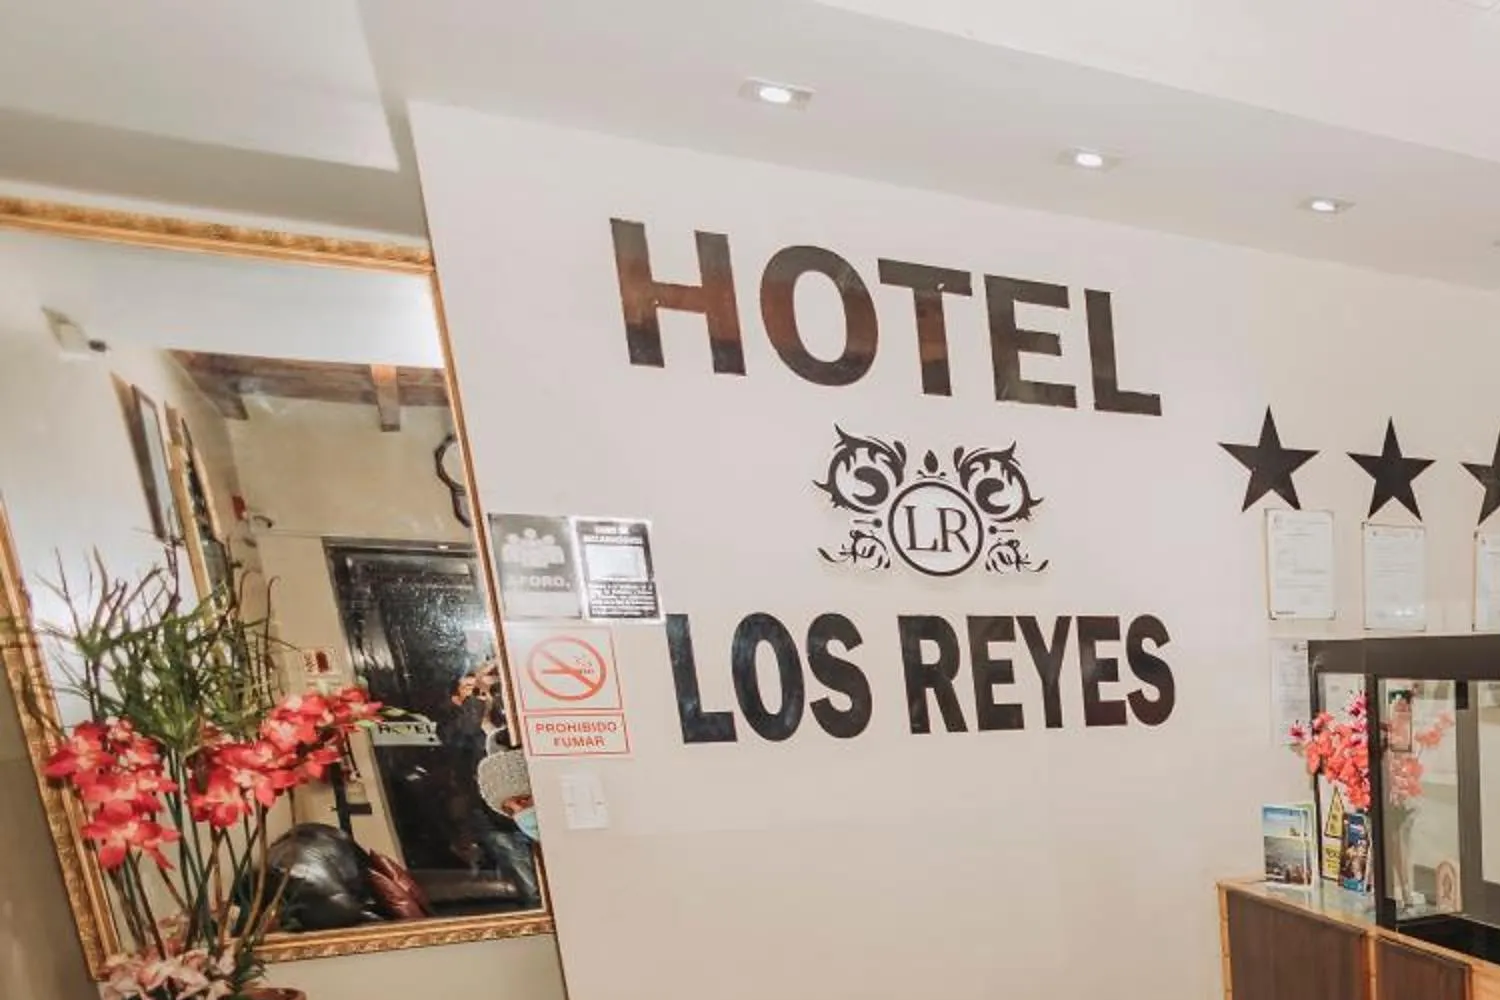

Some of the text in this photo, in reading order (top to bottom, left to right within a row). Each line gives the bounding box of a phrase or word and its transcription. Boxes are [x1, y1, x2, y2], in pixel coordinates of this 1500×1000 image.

[609, 217, 1162, 416] HOTEL
[903, 505, 970, 553] LR
[665, 612, 873, 744] LOS
[898, 613, 1175, 735] REYES
[378, 724, 431, 735] HEL
[535, 722, 617, 734] PROHIBIDO
[553, 735, 605, 748] FUMAR
